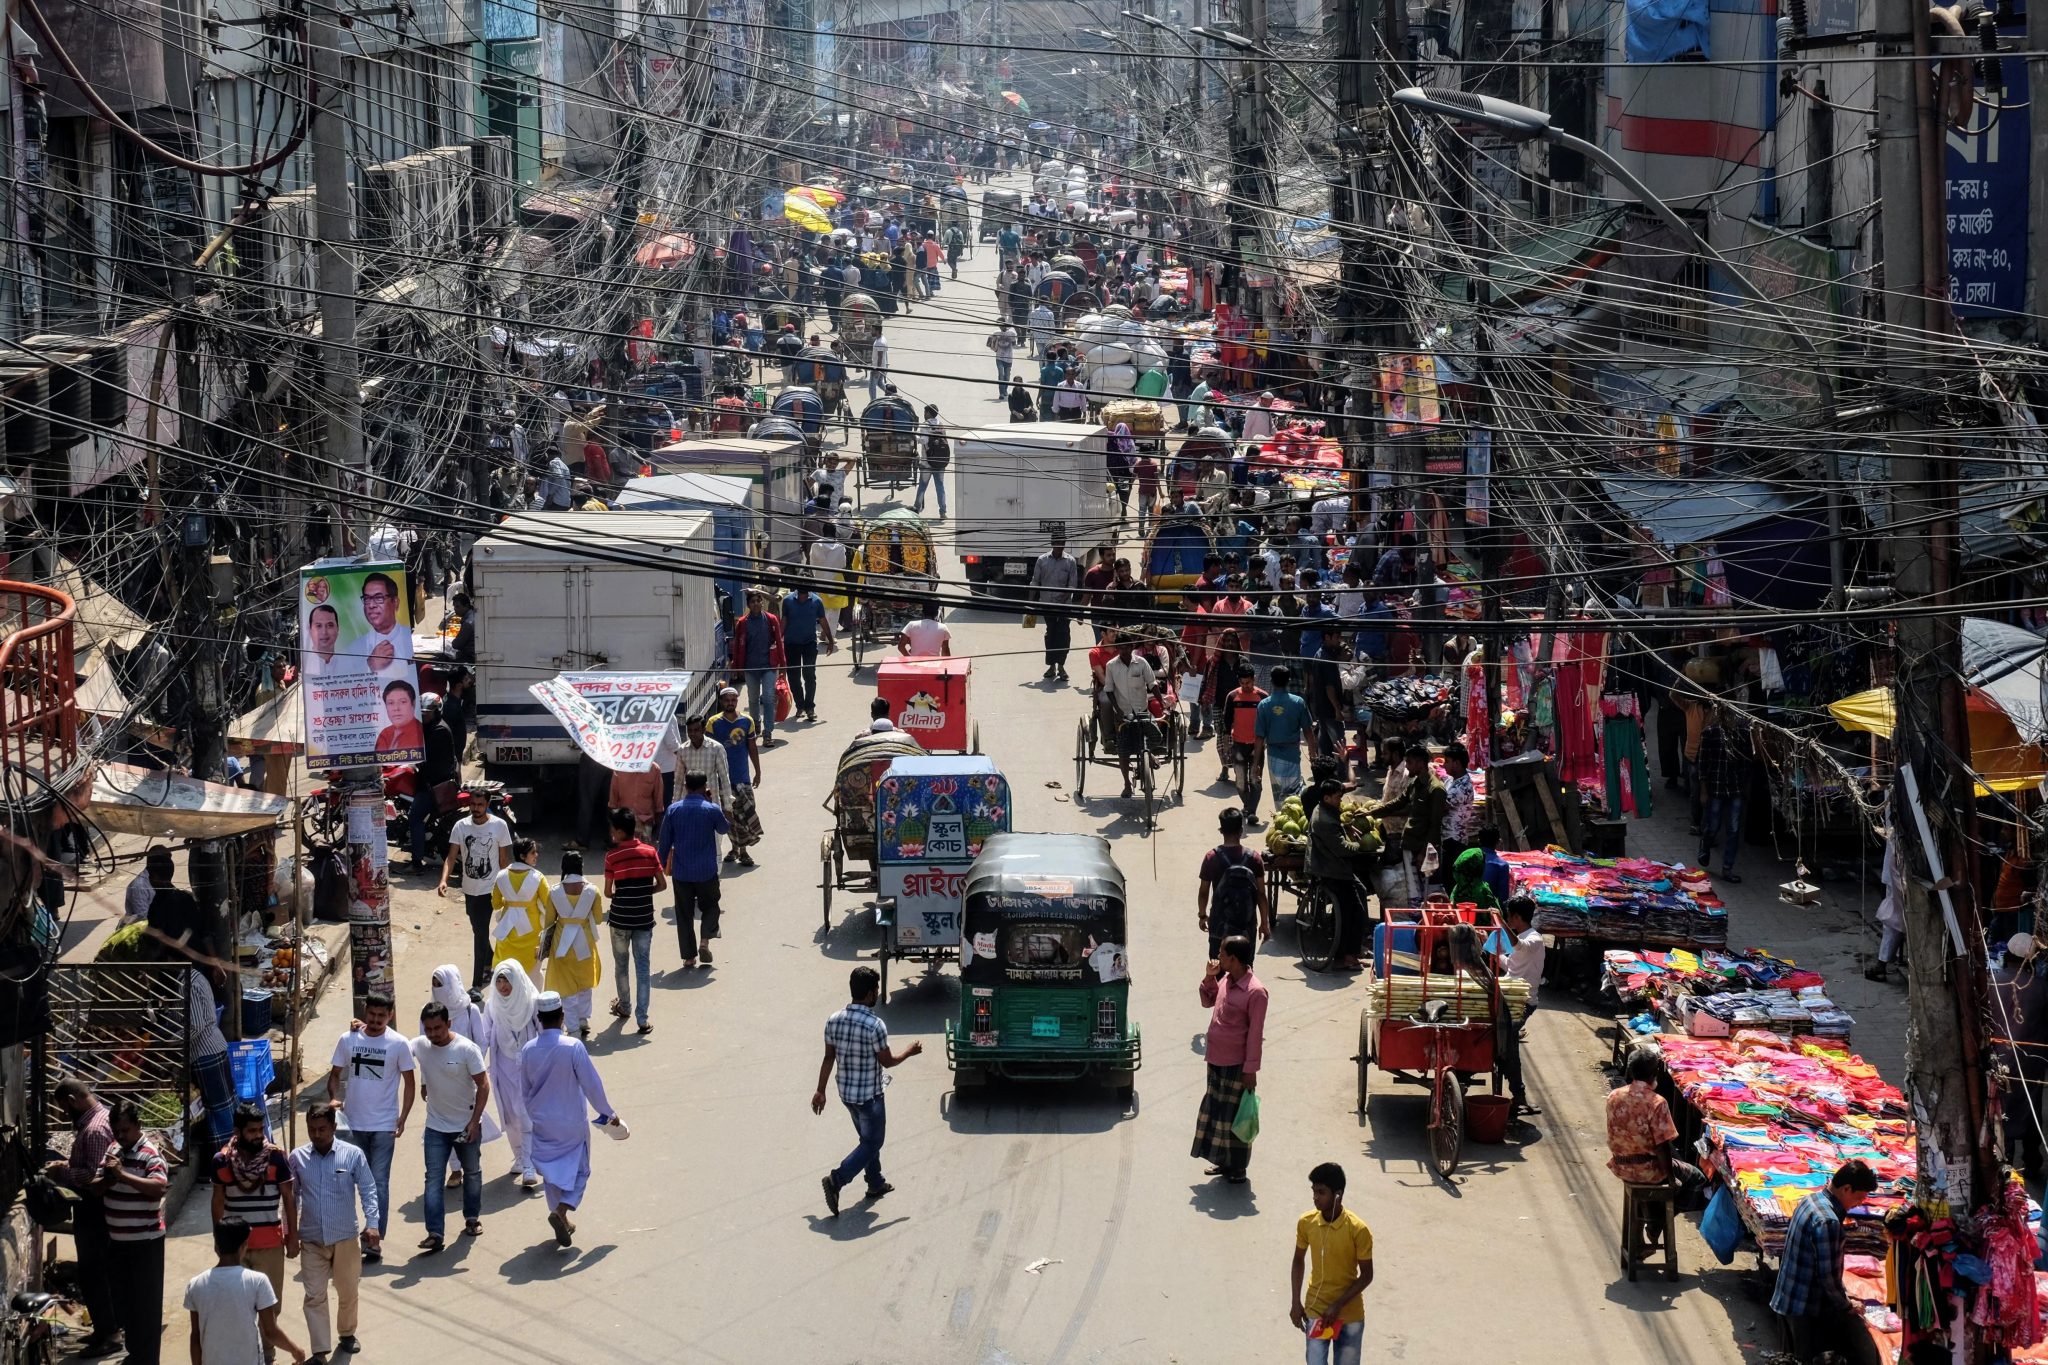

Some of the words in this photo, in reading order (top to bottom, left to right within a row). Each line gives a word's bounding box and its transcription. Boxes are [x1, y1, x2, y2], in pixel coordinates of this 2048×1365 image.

[1959, 208, 1993, 235] মার্কেট
[312, 690, 328, 701] জনাব
[616, 683, 632, 692] ও
[634, 682, 672, 694] দ্রুত
[621, 696, 678, 723] লেখা
[902, 714, 942, 728] পোলার
[932, 822, 961, 838] স্কুল
[928, 839, 962, 853] কোচ
[902, 866, 968, 898] প্রাইভে
[922, 912, 954, 936] স্কুল
[1005, 969, 1032, 980] নামাজ
